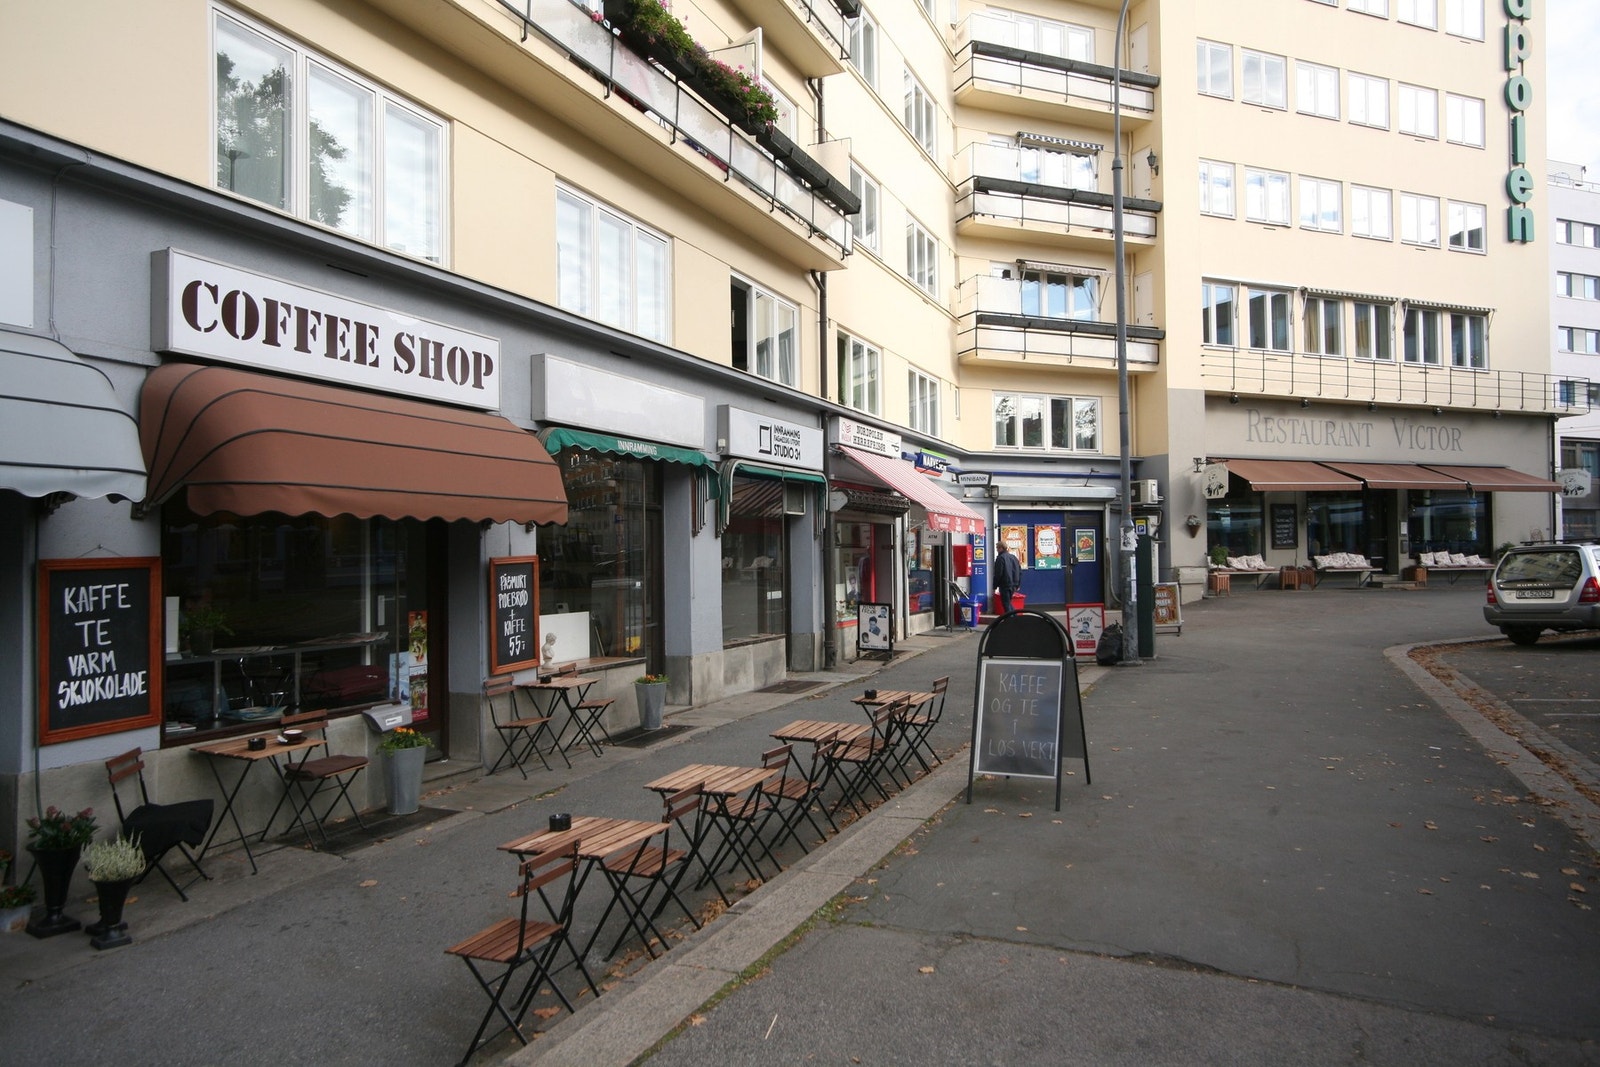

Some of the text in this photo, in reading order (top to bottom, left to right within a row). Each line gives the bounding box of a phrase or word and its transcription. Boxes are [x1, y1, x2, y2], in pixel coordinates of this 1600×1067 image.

[181, 279, 494, 390] COFFEE SHOP
[773, 423, 801, 440] INNRAMMING
[1246, 408, 1464, 452] RESTAURANT VICTOR
[617, 439, 658, 456] INNRAMMING
[773, 443, 795, 460] STUDIO
[500, 573, 527, 591] PÅSMURT
[64, 583, 132, 615] KAFFE
[75, 619, 112, 647] TE
[504, 618, 526, 636] KAFFE
[68, 650, 117, 677] VARM
[57, 670, 148, 709] SKJOKOLADE
[999, 673, 1048, 695] KAFFE
[990, 697, 1040, 716] OG TE
[988, 738, 1016, 758] LØS
